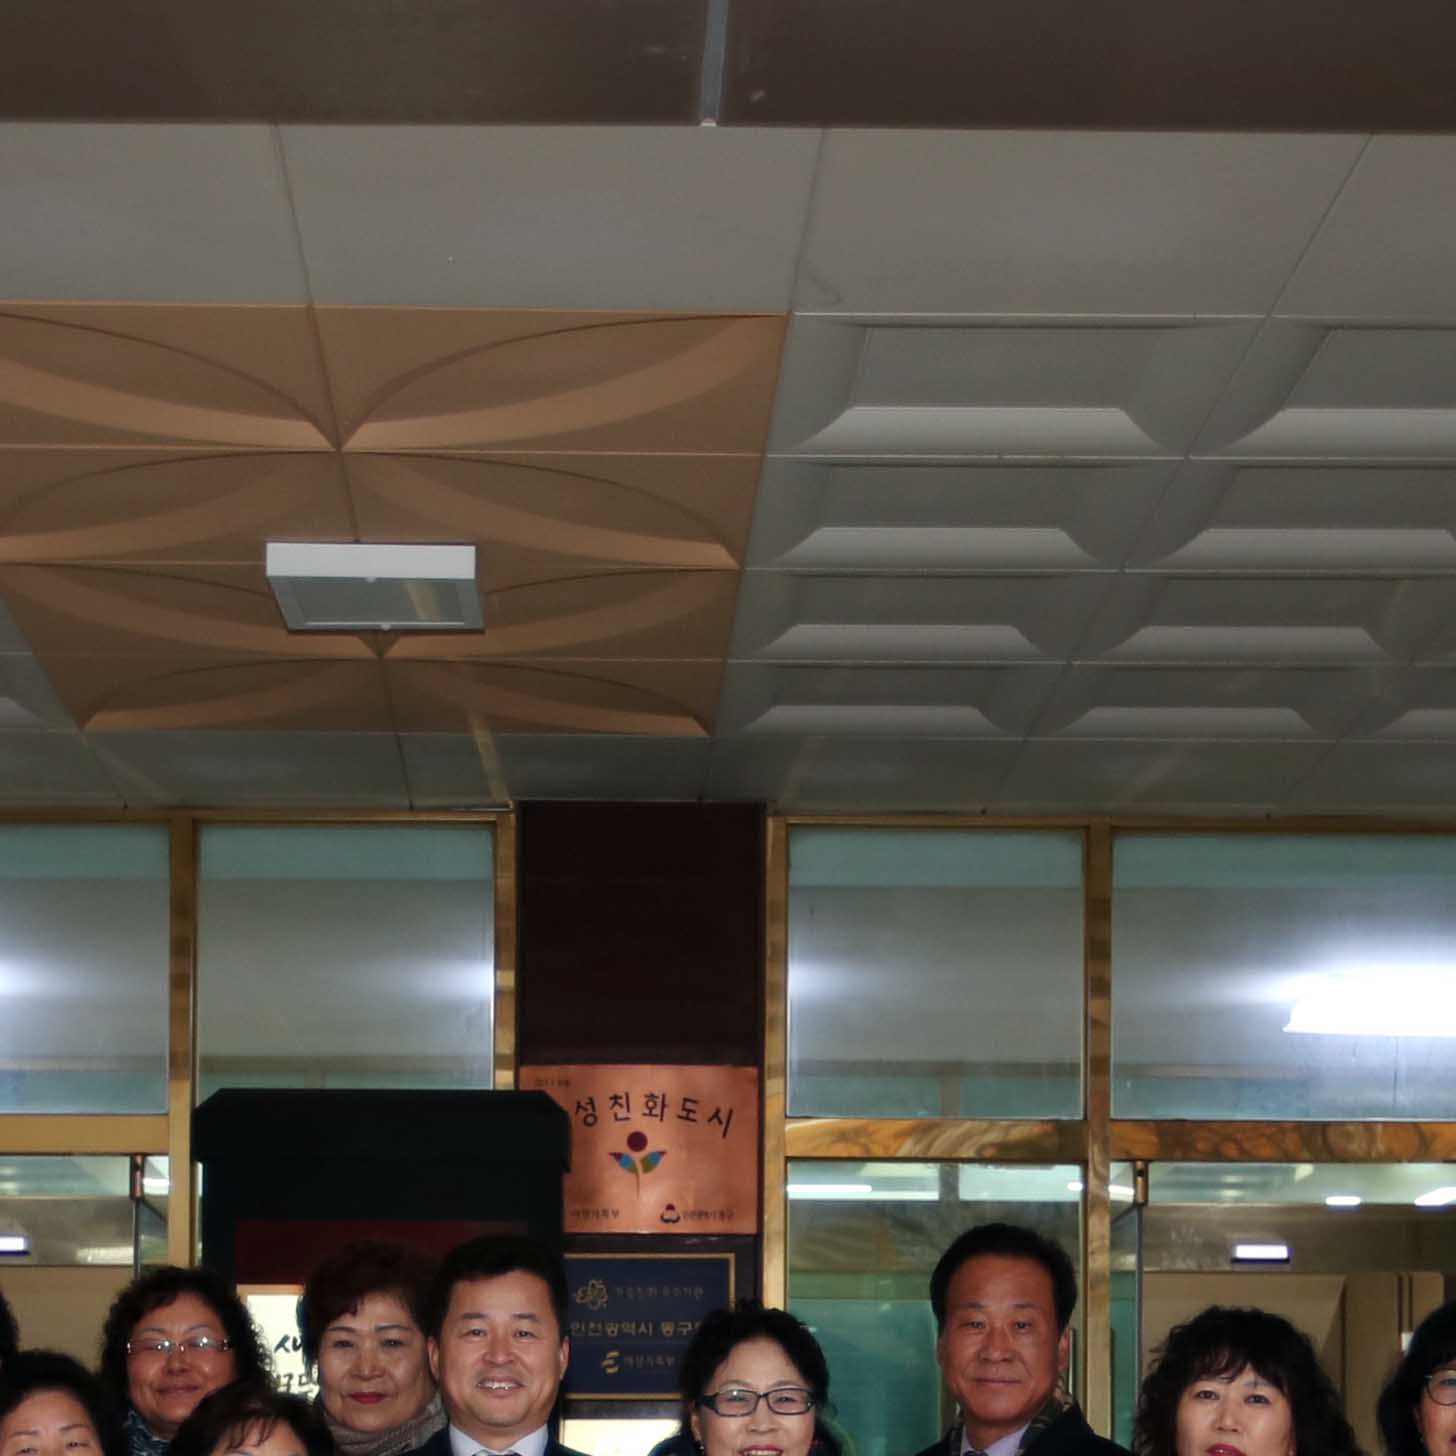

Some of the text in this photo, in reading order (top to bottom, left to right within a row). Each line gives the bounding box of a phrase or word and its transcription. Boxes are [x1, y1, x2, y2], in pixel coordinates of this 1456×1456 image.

[575, 1092, 733, 1138] 성친화도시
[571, 1320, 702, 1337] 인천광역시 동구
